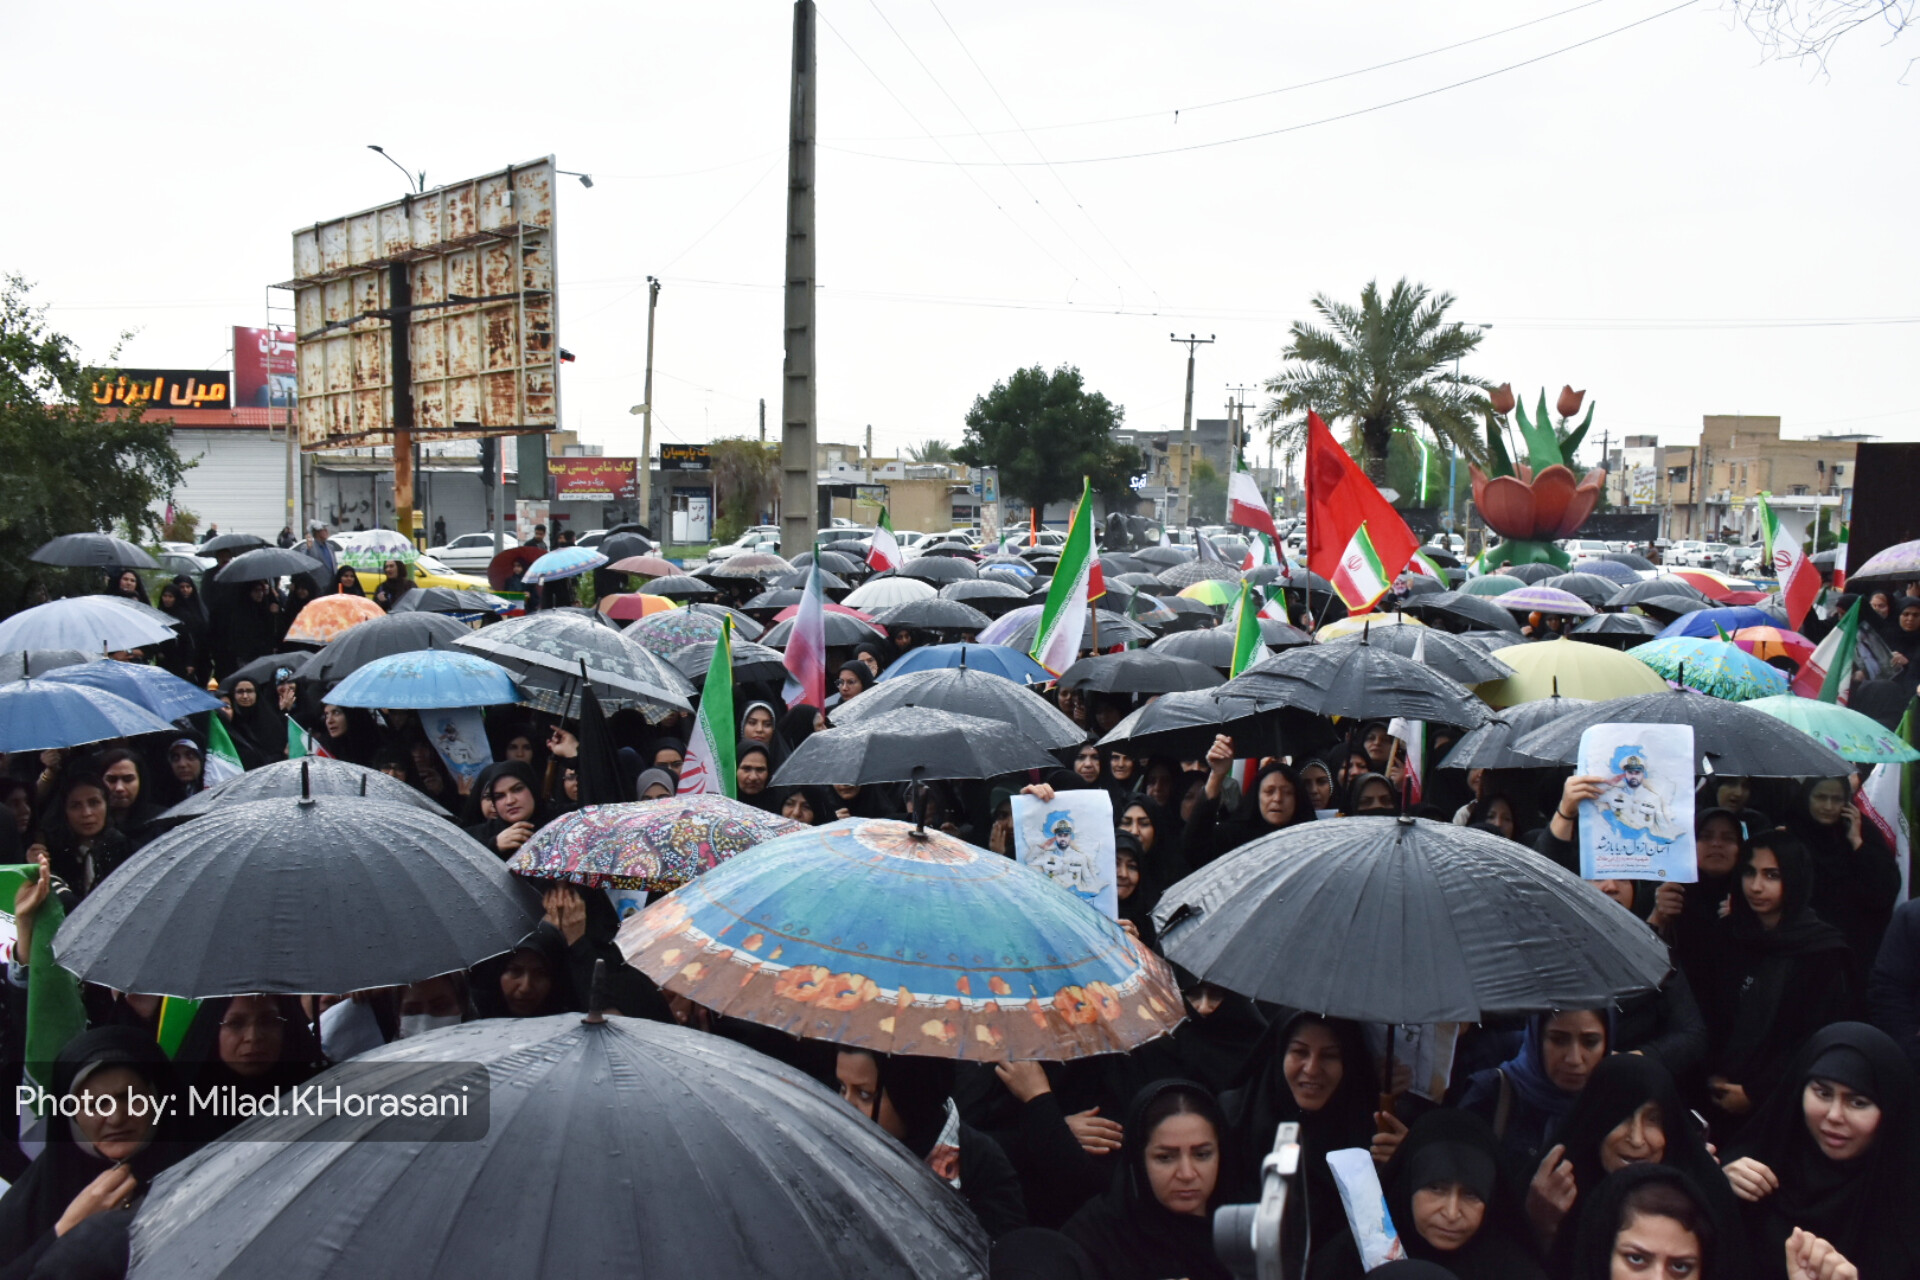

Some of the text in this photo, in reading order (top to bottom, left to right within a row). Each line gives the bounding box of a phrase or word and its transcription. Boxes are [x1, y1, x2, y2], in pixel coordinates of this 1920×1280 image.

[169, 378, 226, 407] مبل
[663, 447, 696, 461] پارسیان
[614, 461, 634, 475] کباب
[1615, 843, 1627, 856] دریا
[1645, 842, 1671, 856] آسمان
